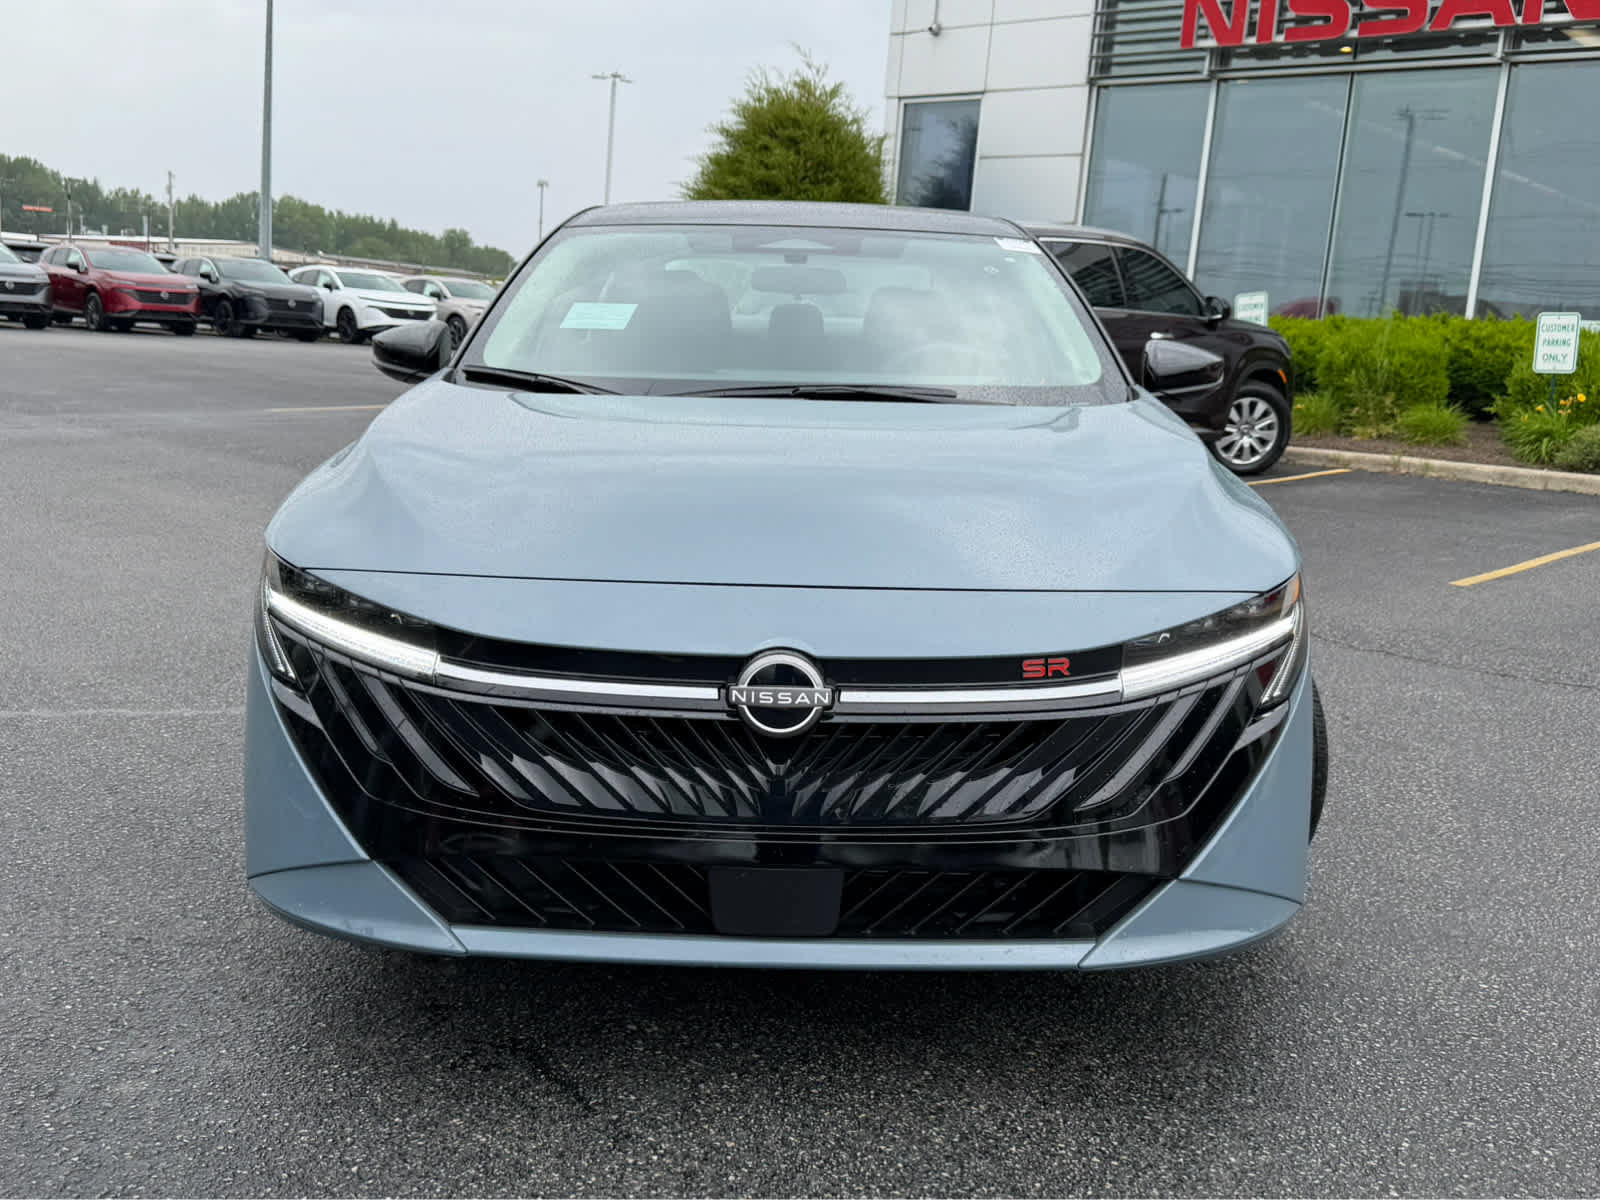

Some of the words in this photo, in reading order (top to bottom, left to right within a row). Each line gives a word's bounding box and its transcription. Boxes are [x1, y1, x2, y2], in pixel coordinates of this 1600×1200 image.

[1541, 323, 1575, 333] CUSTOMER
[1542, 338, 1571, 347] PARKING
[1542, 352, 1568, 362] ONLY
[1022, 657, 1071, 679] SR
[731, 689, 829, 705] NISSAN
